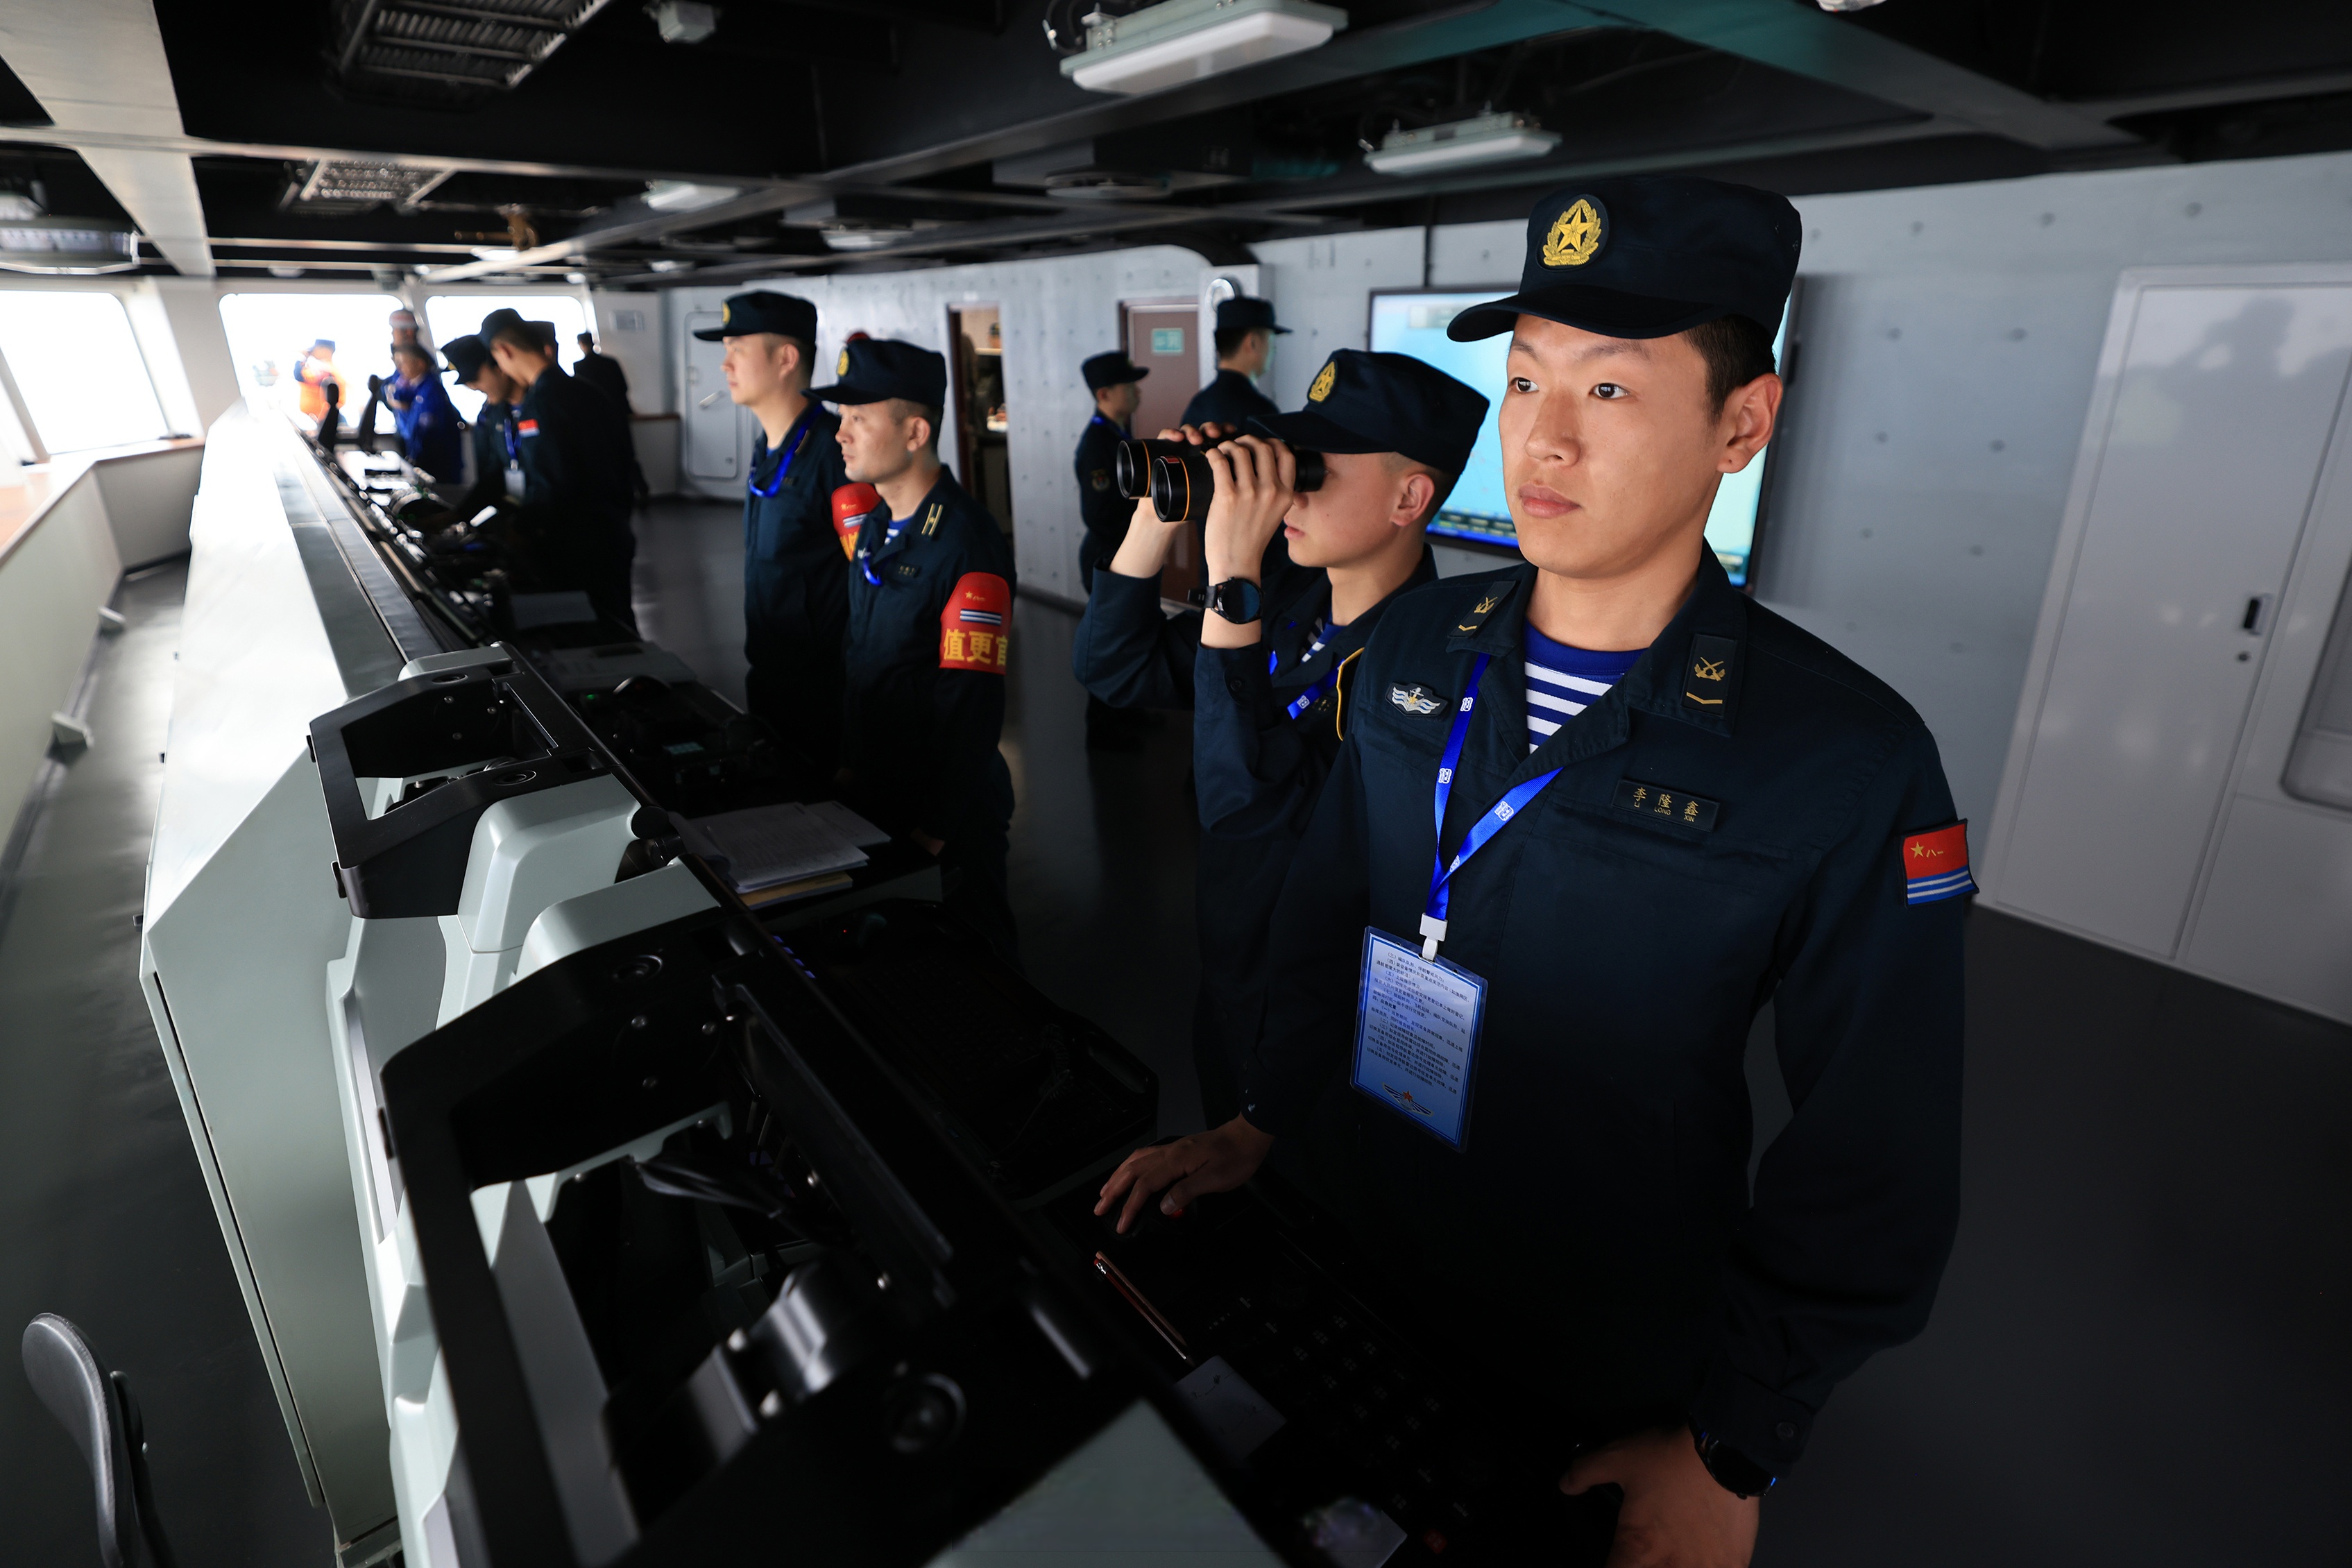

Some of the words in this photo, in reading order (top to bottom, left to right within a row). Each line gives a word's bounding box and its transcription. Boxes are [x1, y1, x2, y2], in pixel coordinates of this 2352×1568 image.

[1653, 806, 1671, 816] LONG
[1683, 815, 1695, 823] XIN
[1926, 849, 1944, 858] 八一
